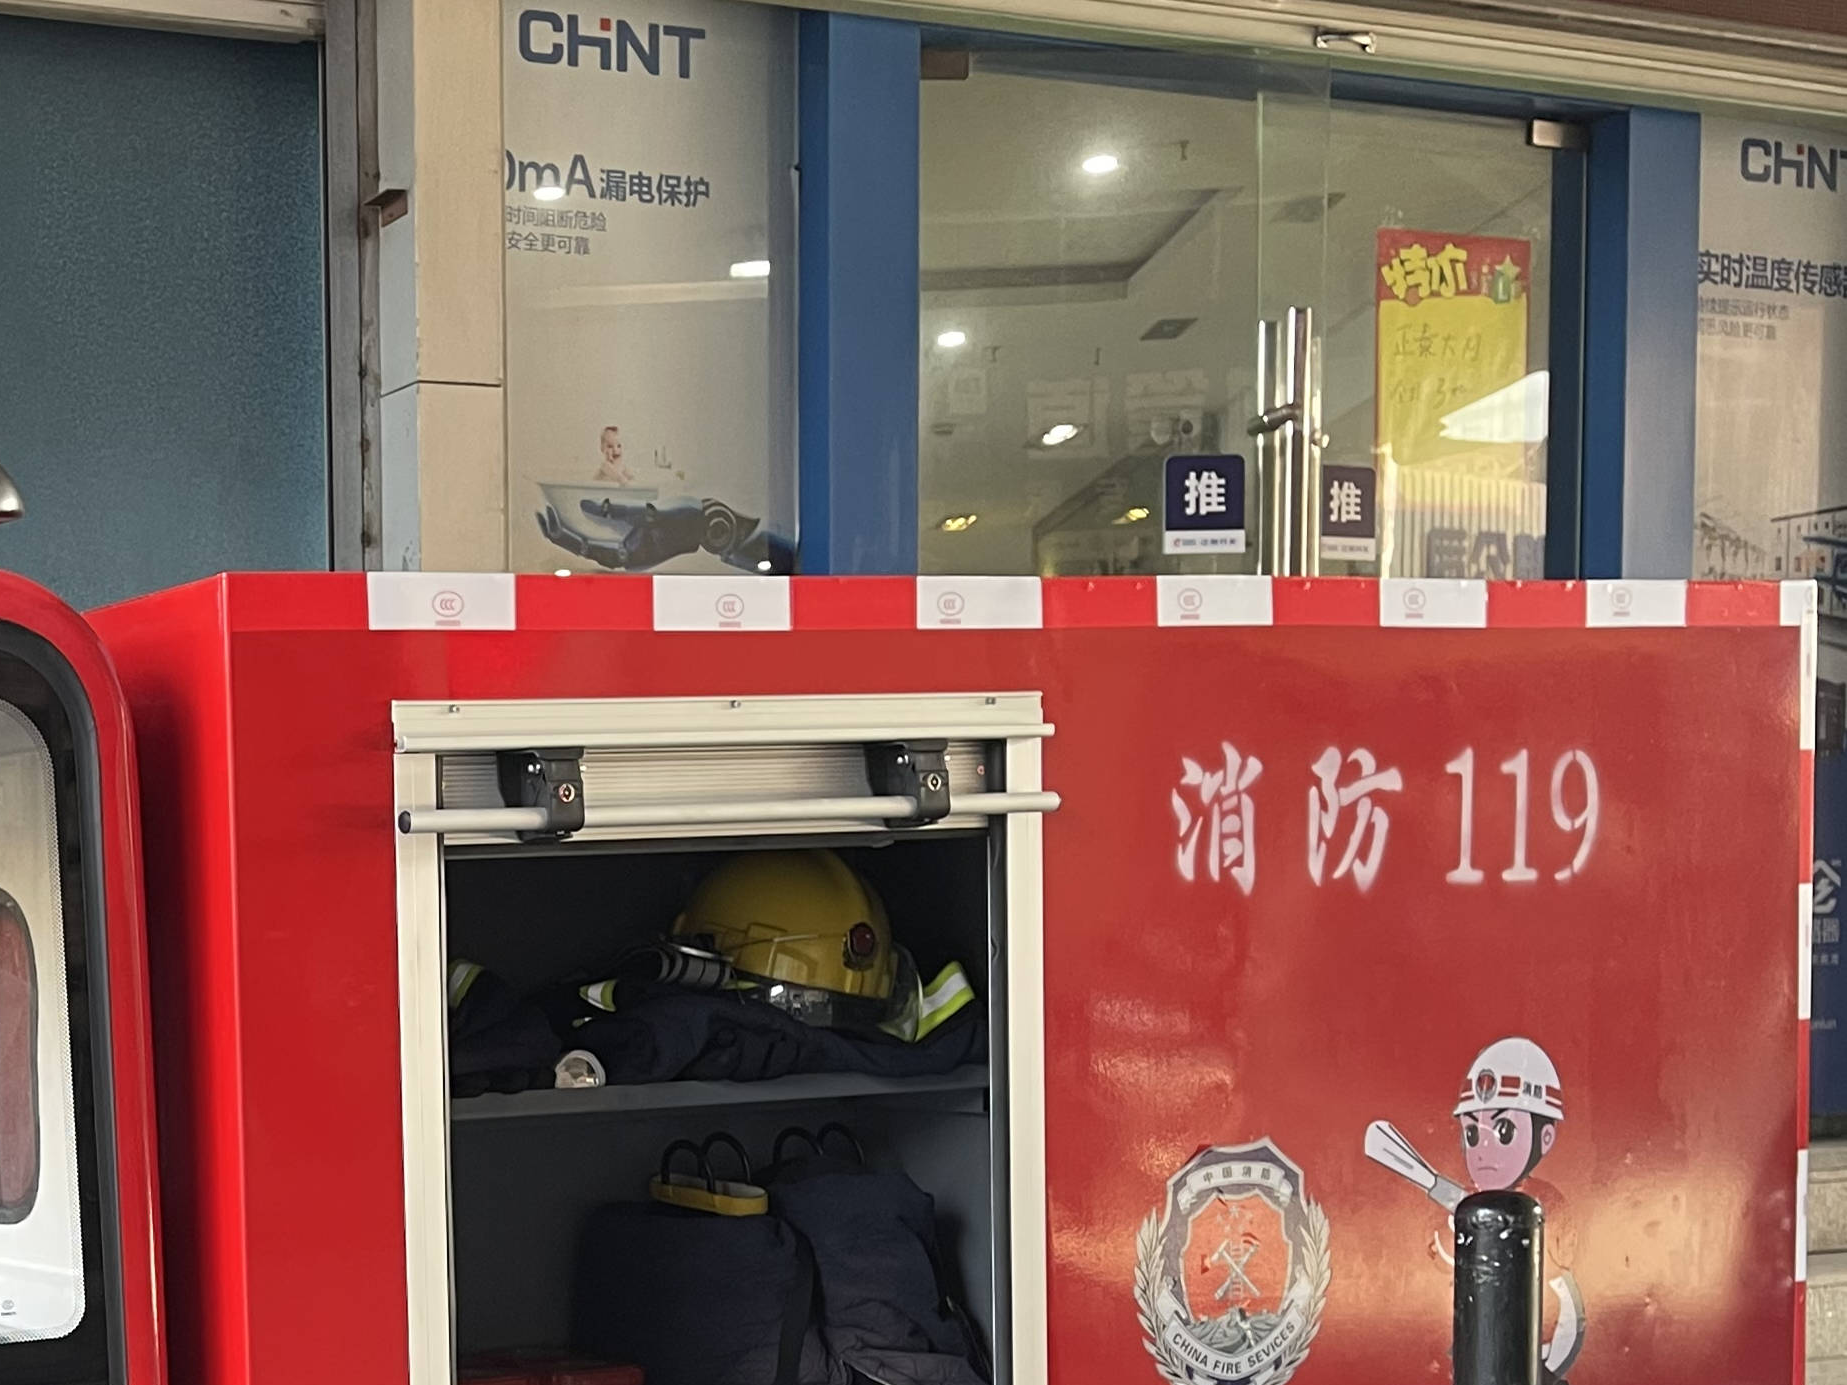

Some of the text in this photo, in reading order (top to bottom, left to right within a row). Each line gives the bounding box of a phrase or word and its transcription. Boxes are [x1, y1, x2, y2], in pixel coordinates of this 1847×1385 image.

[1741, 138, 1847, 192] CHIN
[1698, 249, 1847, 299] 实时温度传感
[1184, 471, 1226, 515] 推
[1330, 480, 1362, 523] 推
[1171, 741, 1600, 896] 消防 119
[1172, 1321, 1295, 1375] CHINA FIRE SEVICES
